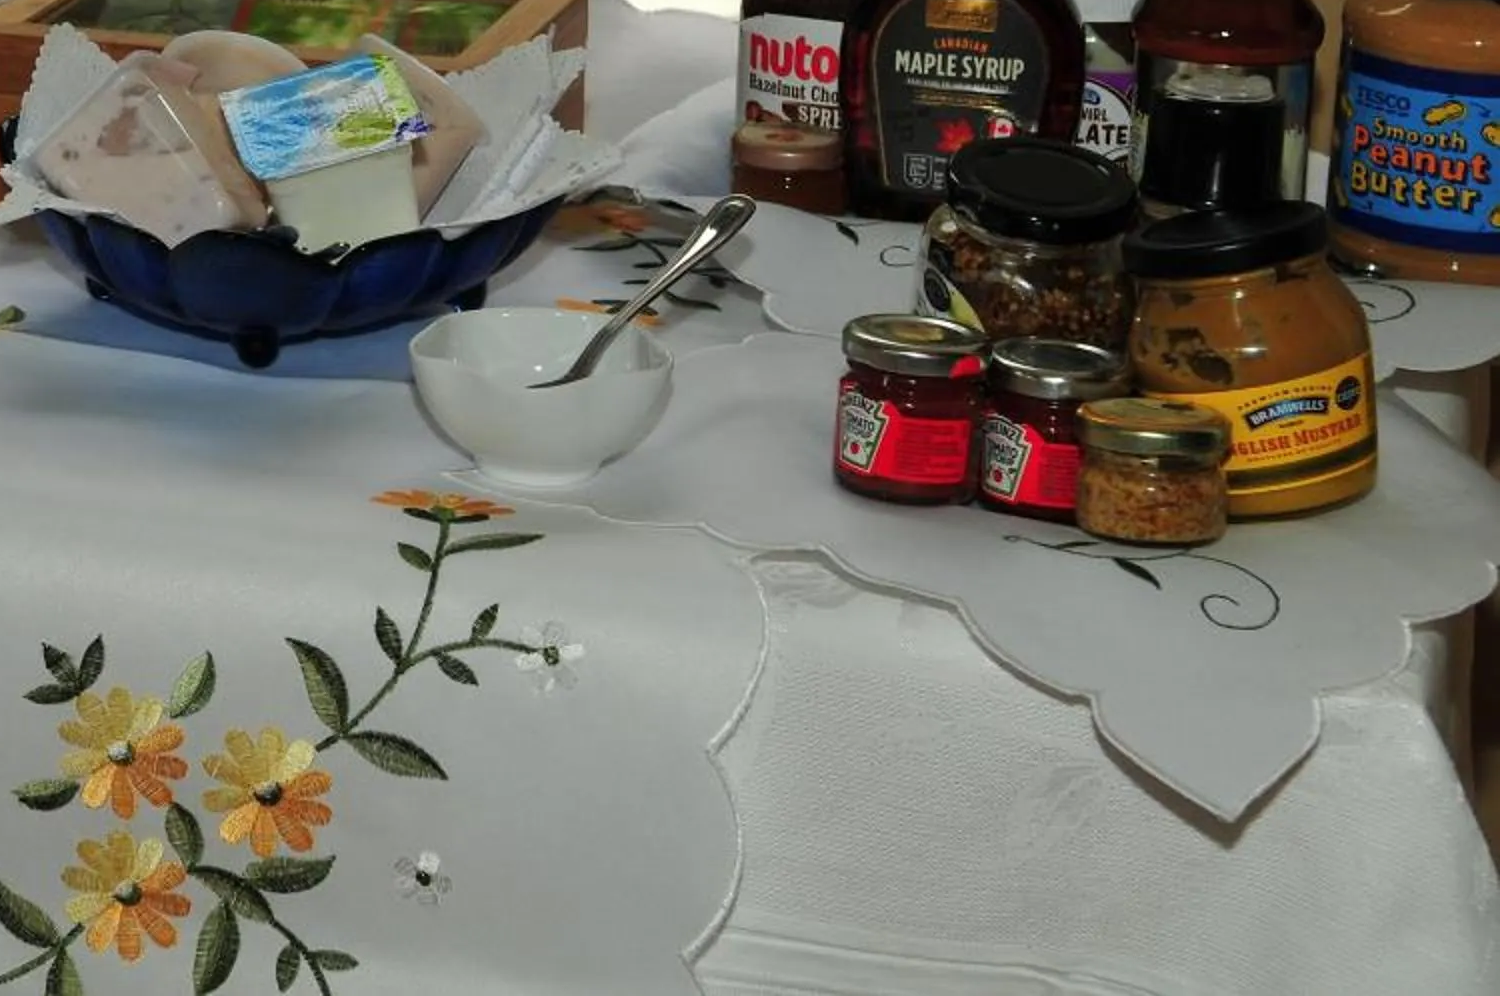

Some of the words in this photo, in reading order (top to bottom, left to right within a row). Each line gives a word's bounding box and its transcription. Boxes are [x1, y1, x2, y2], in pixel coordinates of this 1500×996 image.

[895, 49, 957, 77] MAPLE
[961, 56, 1026, 82] SYRUP
[749, 72, 807, 100] Hazelnut
[1358, 86, 1411, 111] TESCO
[1371, 116, 1467, 152] Smooth
[1351, 123, 1490, 184] Peanut
[1350, 159, 1481, 213] Butter
[1249, 399, 1325, 425] BRAMWELLS
[1293, 413, 1361, 445] MUSTARD
